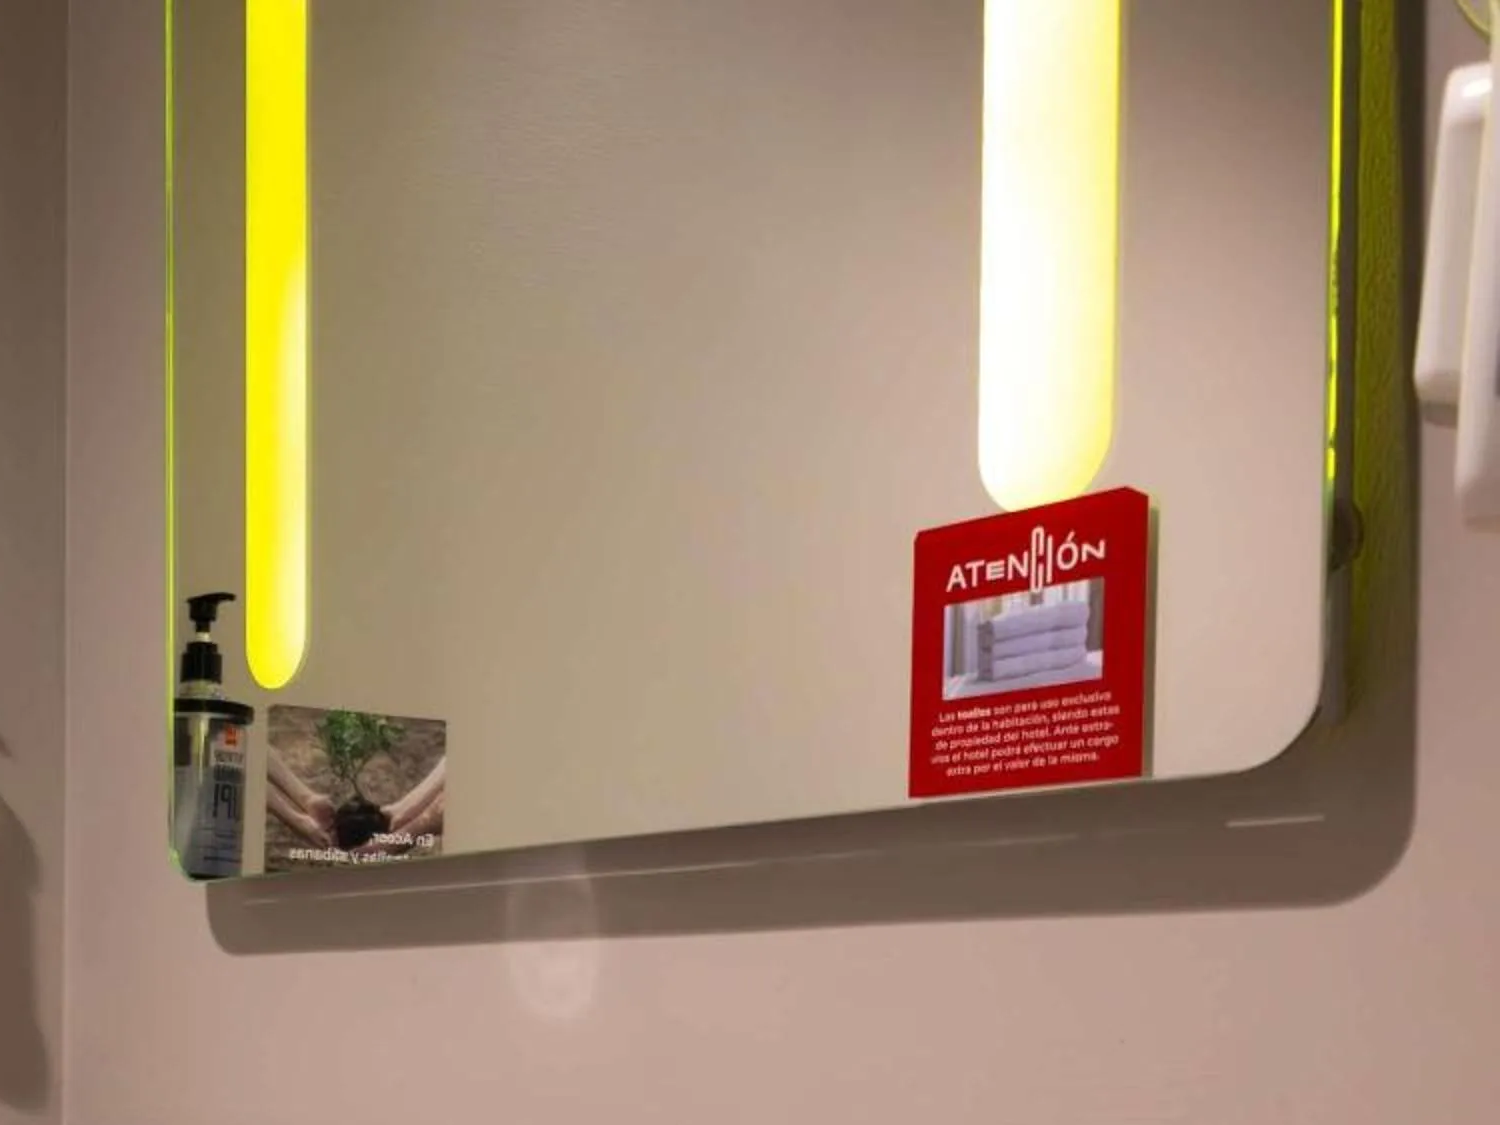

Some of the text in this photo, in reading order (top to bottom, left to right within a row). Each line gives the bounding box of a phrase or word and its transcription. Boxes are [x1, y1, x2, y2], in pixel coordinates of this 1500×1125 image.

[939, 712, 955, 723] Las
[1061, 691, 1112, 707] exclusivo
[932, 723, 964, 737] dentro
[966, 722, 979, 733] de
[981, 720, 990, 730] la
[935, 739, 948, 751] de
[950, 731, 1001, 750] propiedad
[1003, 730, 1020, 743] del
[1021, 726, 1051, 740] hotel.
[951, 750, 961, 762] el
[963, 747, 989, 760] hotel
[1023, 739, 1067, 755] efectuar
[1070, 738, 1085, 748] un
[1087, 735, 1119, 748] cargo
[946, 764, 971, 776] extra
[973, 762, 991, 775] por
[993, 759, 1003, 771] el
[1032, 754, 1047, 766] de
[1048, 753, 1058, 764] la
